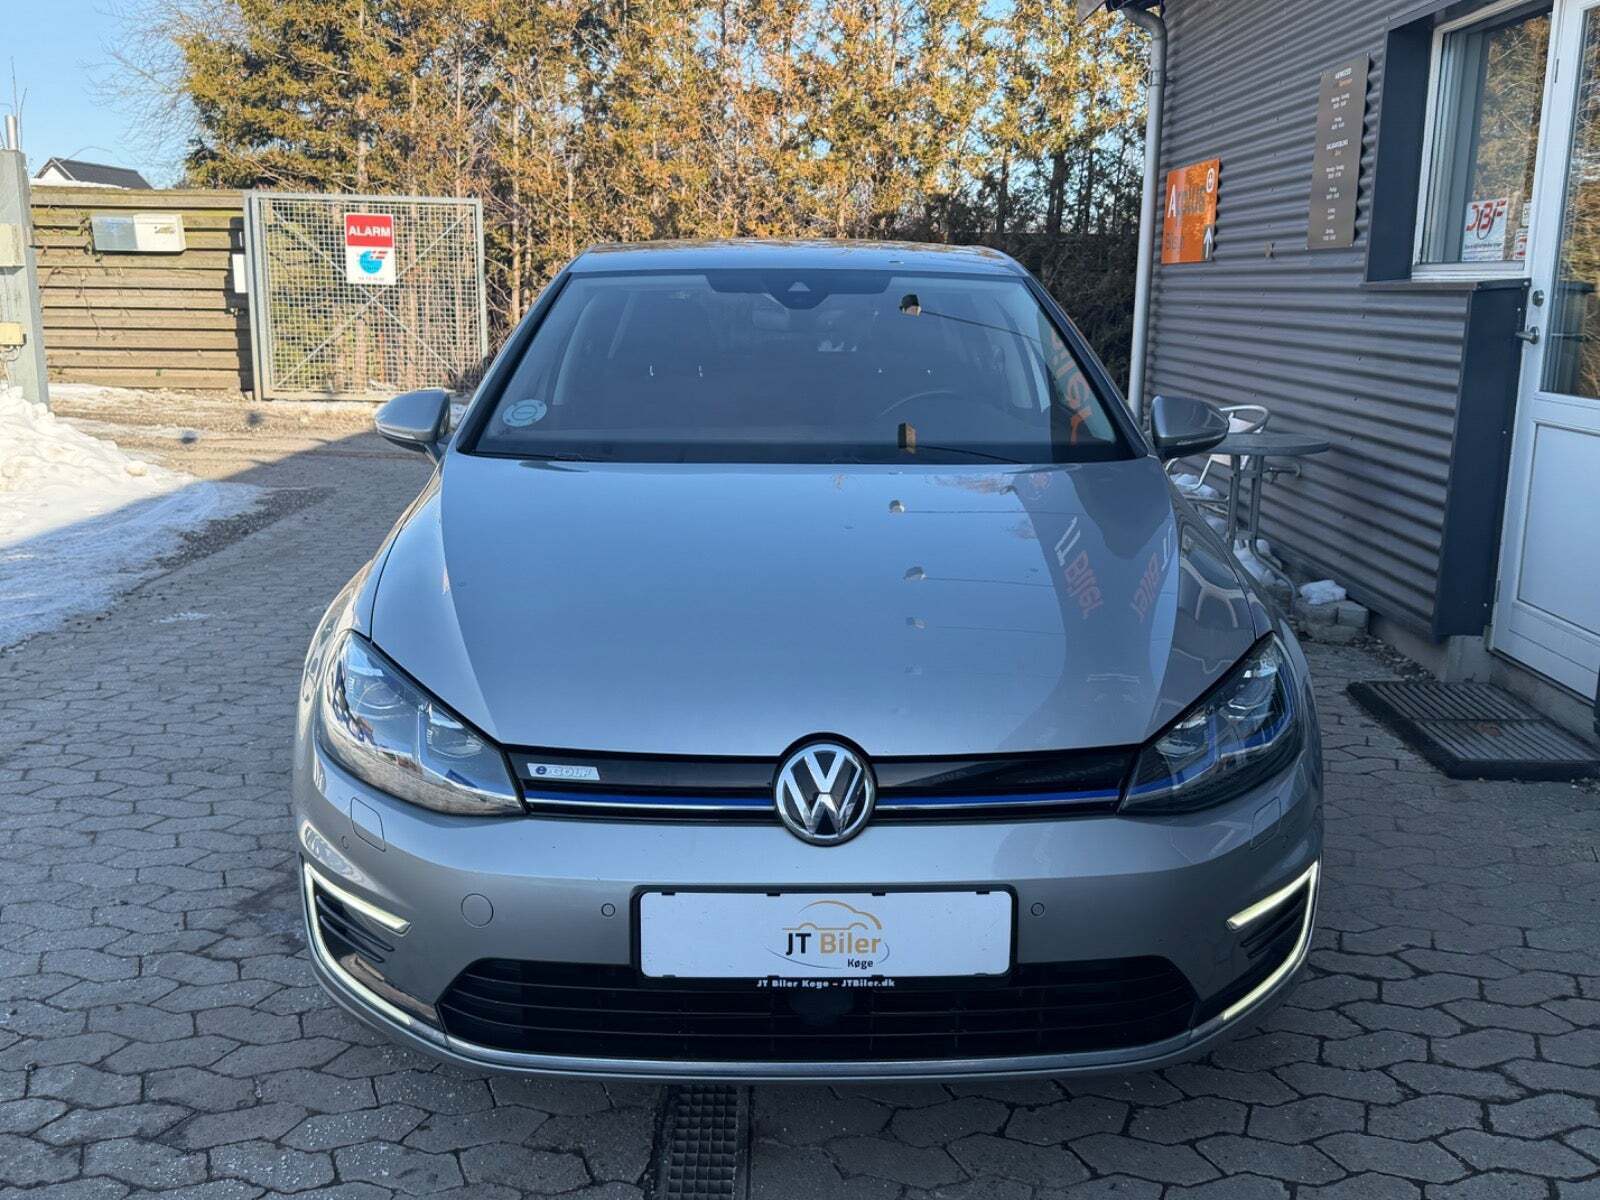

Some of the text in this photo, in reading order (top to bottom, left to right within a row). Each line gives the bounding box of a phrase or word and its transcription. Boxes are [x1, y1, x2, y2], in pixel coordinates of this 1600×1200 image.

[348, 225, 391, 237] ALARM
[778, 746, 871, 838] VW
[786, 932, 881, 956] JT Biler
[847, 958, 874, 970] Køge
[756, 979, 769, 988] JT
[772, 979, 798, 988] Biler
[841, 978, 896, 988] JTBiler.dk
